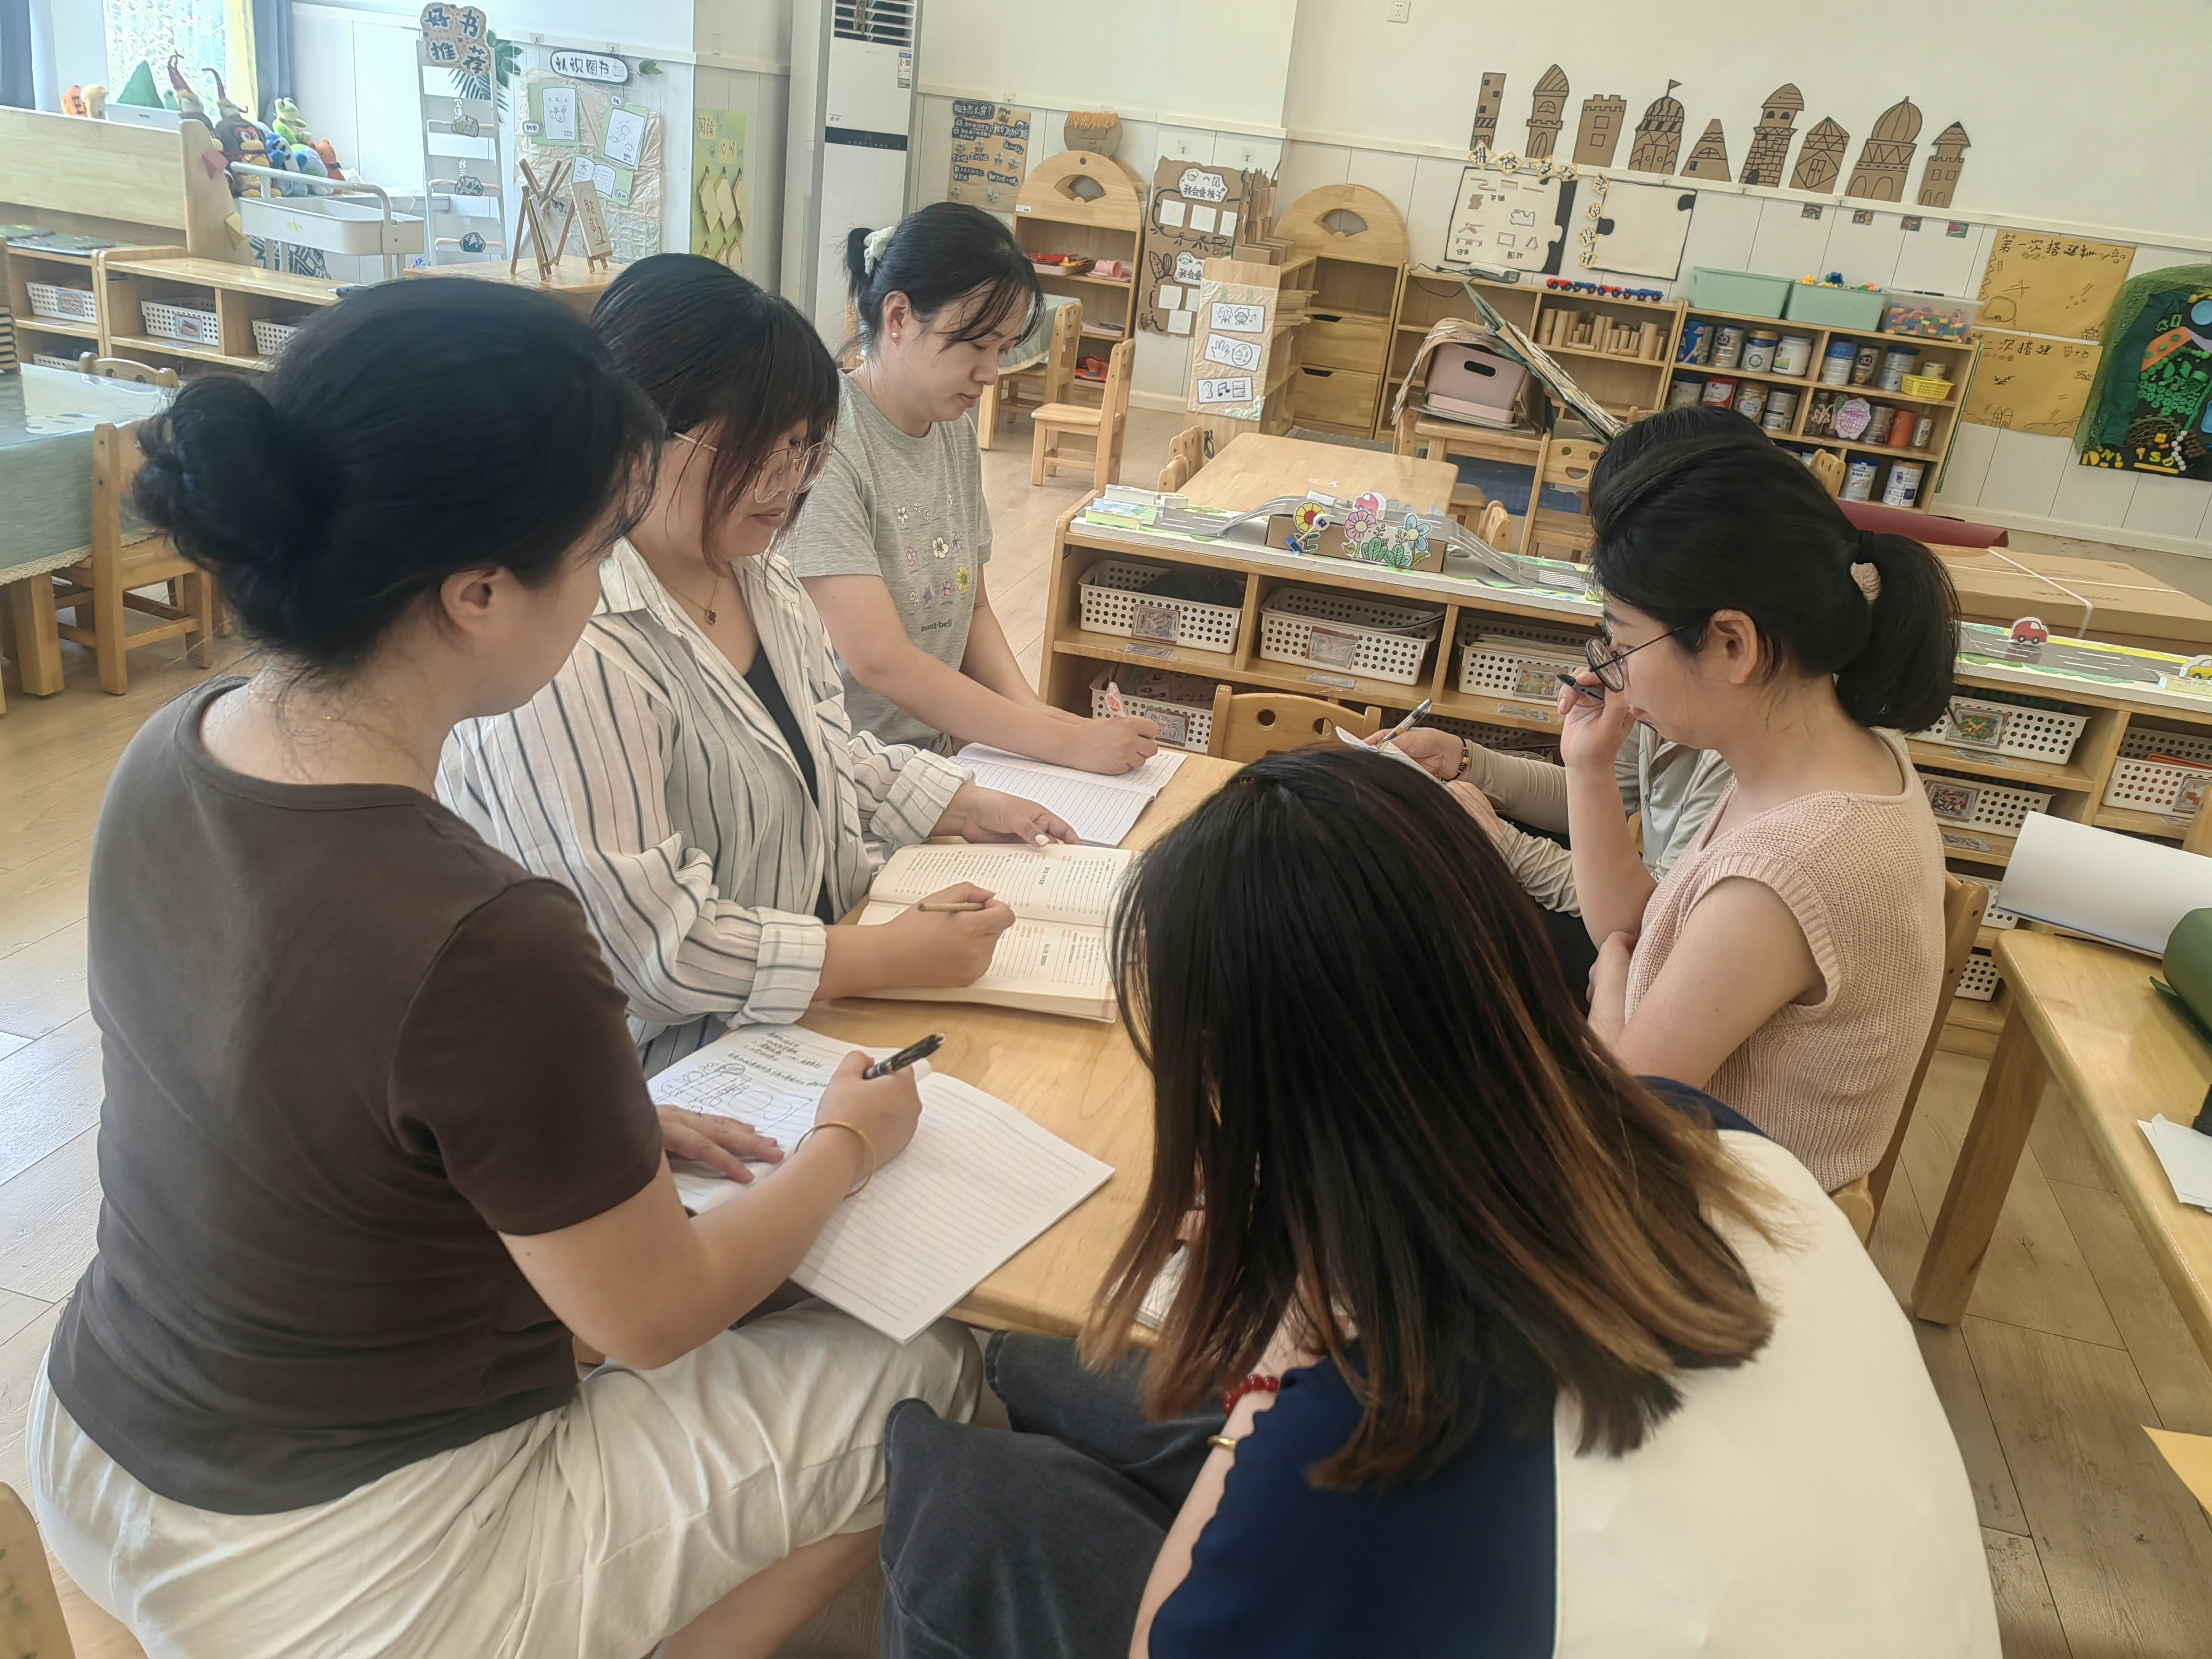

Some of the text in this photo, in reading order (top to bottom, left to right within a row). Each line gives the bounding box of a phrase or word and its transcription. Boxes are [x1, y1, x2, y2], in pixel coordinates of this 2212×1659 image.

[424, 7, 480, 37] 好书
[430, 42, 487, 74] 推荐
[556, 56, 609, 76] 认识图书
[1998, 233, 2076, 256] 第一次搭建
[1860, 356, 1872, 365] a2
